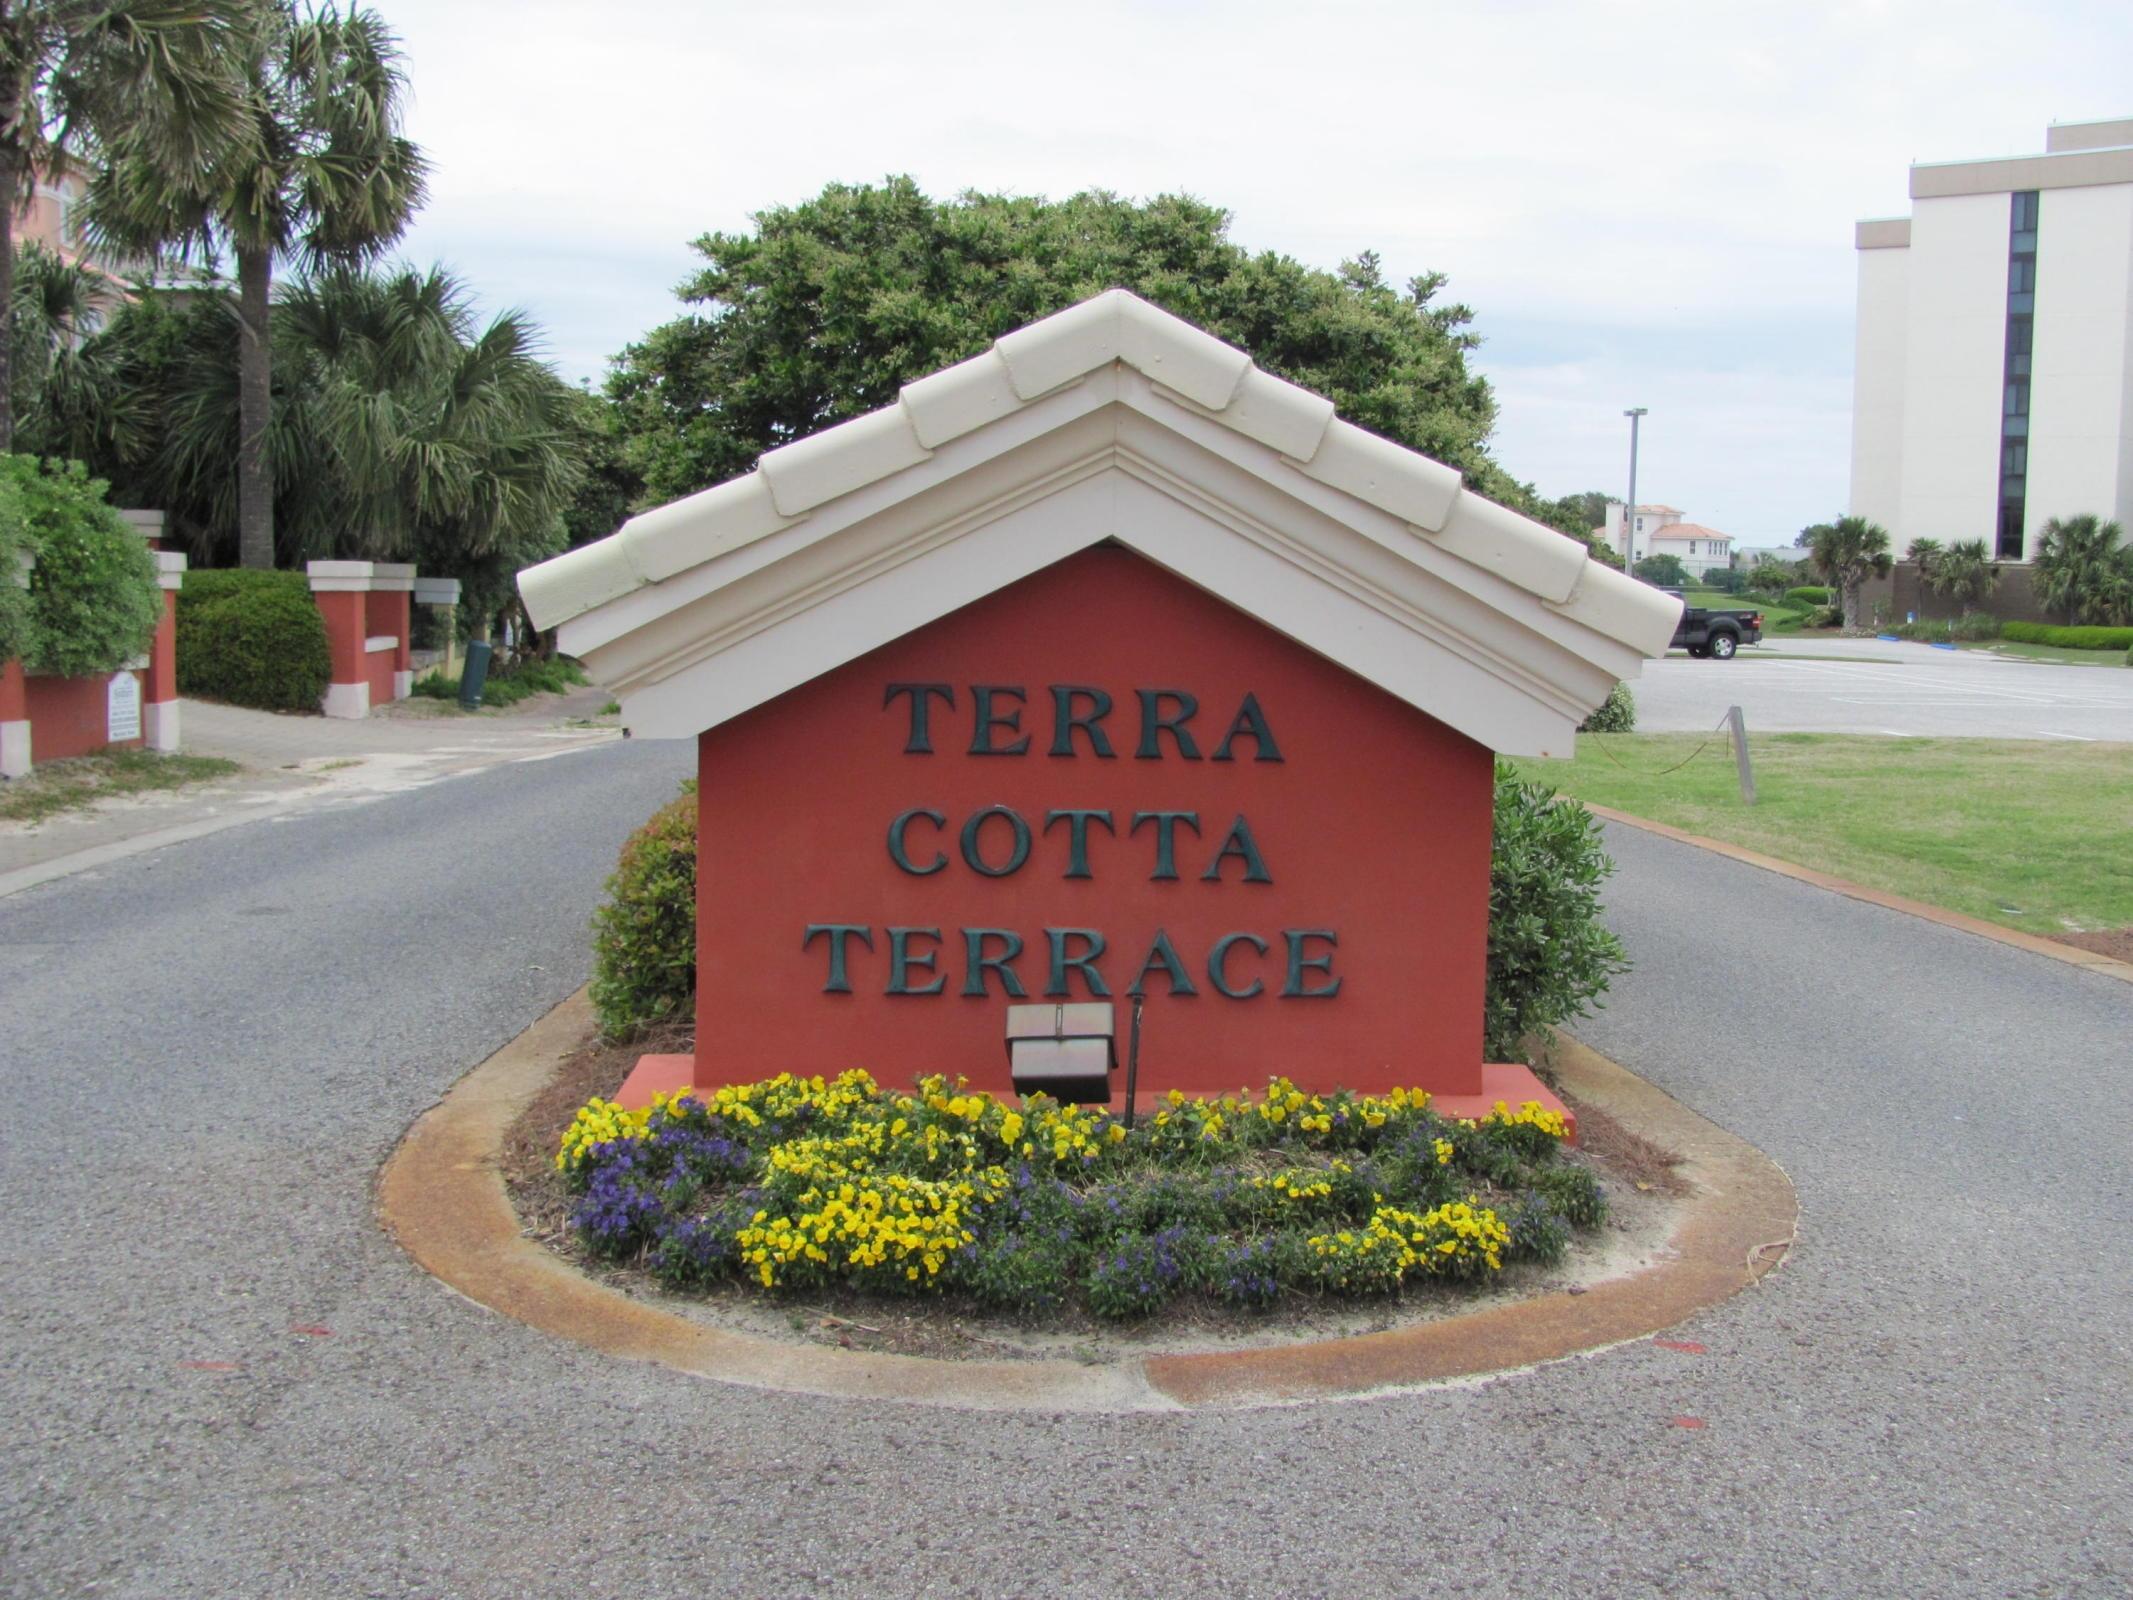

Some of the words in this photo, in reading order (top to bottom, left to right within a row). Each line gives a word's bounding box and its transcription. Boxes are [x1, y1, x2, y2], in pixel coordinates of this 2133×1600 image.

[883, 683, 1285, 762] TERRA
[886, 804, 1274, 884] COTTA
[803, 923, 1343, 999] TERRACE
